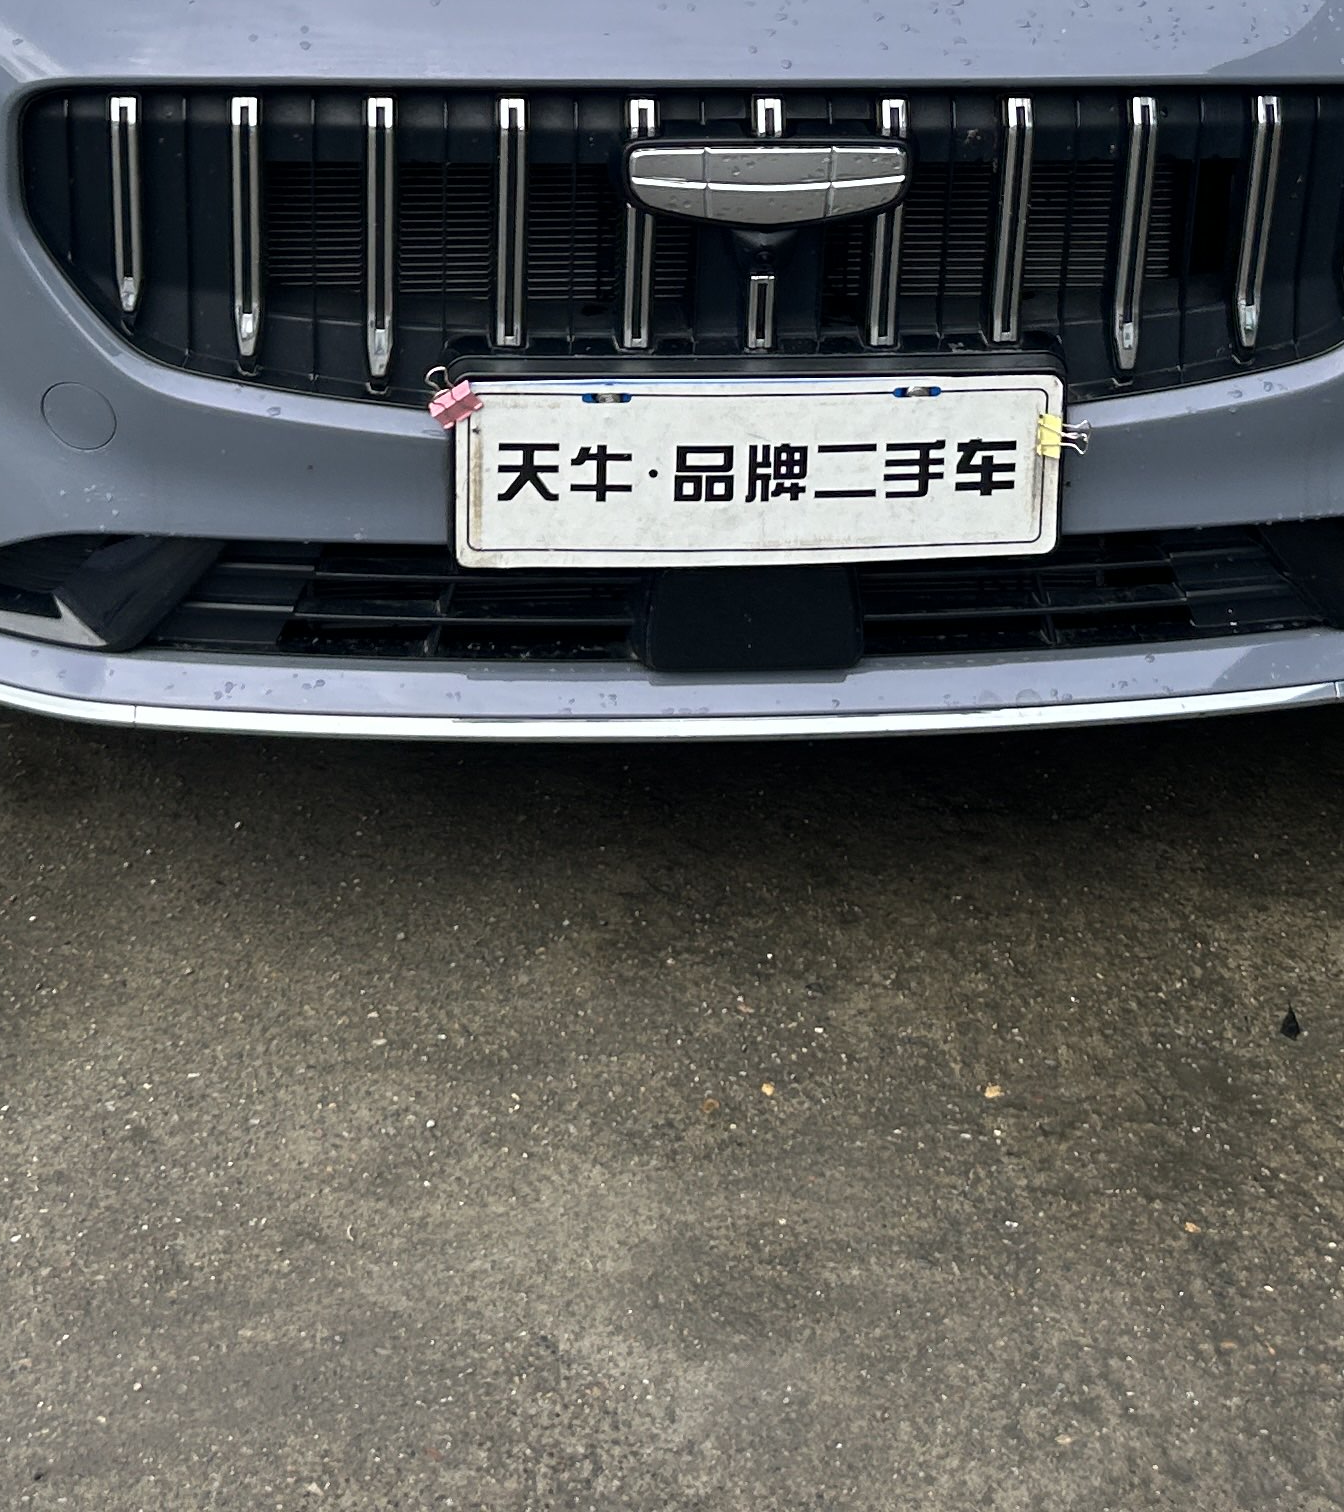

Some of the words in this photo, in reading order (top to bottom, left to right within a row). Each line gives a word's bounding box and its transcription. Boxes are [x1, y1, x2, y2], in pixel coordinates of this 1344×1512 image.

[496, 439, 1017, 503] 天牛·品牌二手车
